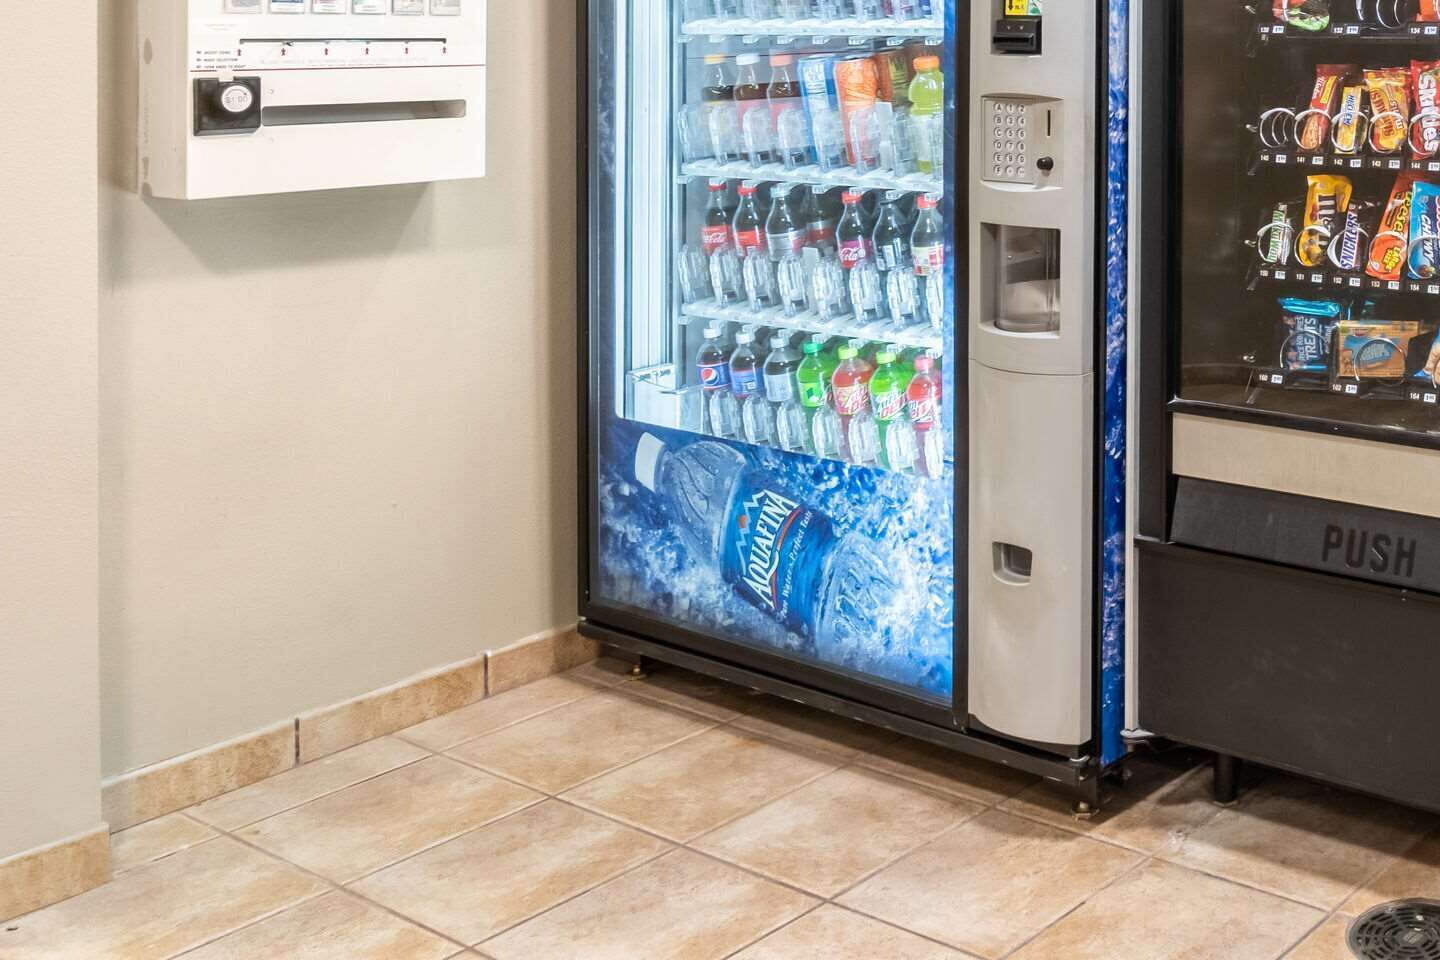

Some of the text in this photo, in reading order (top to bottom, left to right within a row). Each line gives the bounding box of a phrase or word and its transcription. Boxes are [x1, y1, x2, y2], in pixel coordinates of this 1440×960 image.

[1340, 211, 1359, 270] SNICKERS
[742, 489, 801, 610] AQUAFINA
[1322, 523, 1416, 578] PUSH
